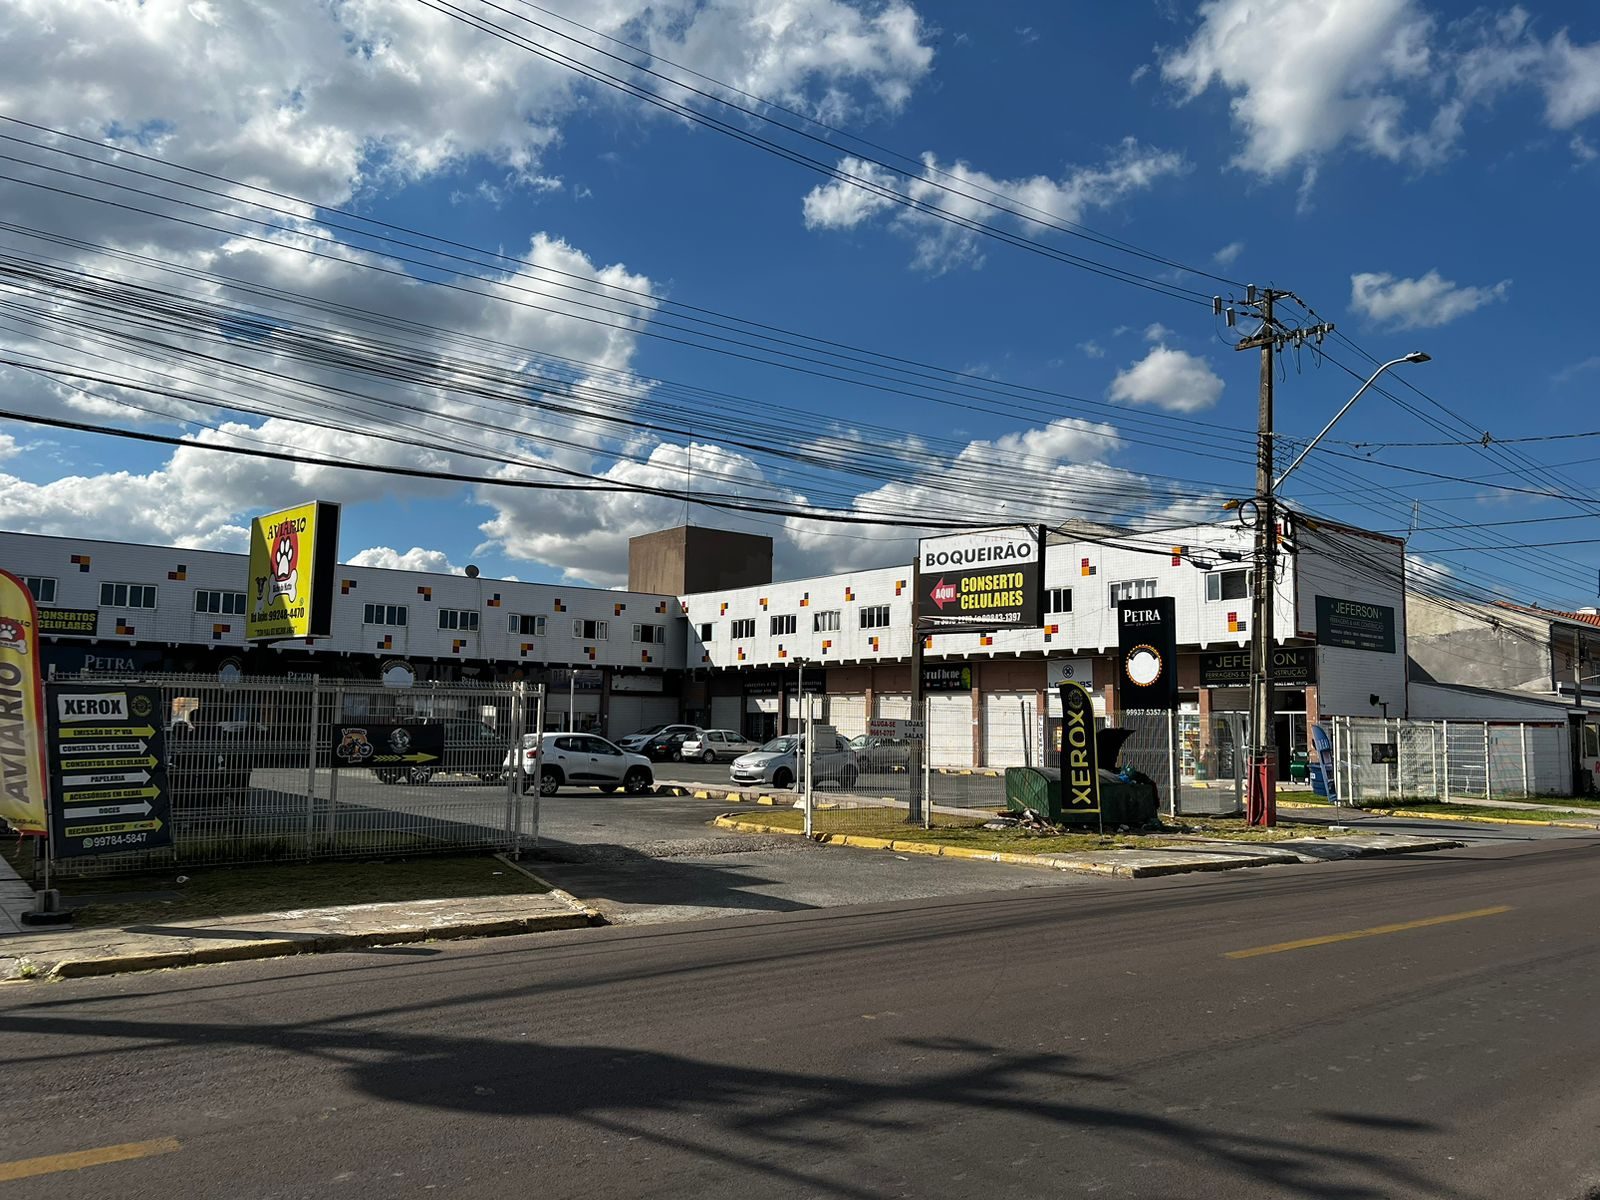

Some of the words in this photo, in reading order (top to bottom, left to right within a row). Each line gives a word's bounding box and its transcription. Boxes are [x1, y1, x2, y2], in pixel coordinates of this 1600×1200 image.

[267, 517, 307, 540] AVIÁRIO
[925, 541, 1032, 567] BOQUEIRÃO
[960, 572, 1024, 593] CONSERTO
[935, 587, 954, 600] AQUI
[960, 590, 1024, 610] CELULARES
[268, 607, 305, 621] 99248-4470
[1123, 609, 1161, 623] PETRA
[1335, 602, 1379, 619] JEFERSON
[39, 620, 93, 630] CELULARES
[84, 654, 135, 670] PETRA
[1215, 653, 1297, 668] JEFEON
[64, 699, 122, 715] XEROX
[62, 744, 97, 752] CONSULTA
[65, 760, 106, 768] CONSERTOS
[1067, 709, 1092, 805] XEROX
[94, 833, 148, 847] 99784-5847
